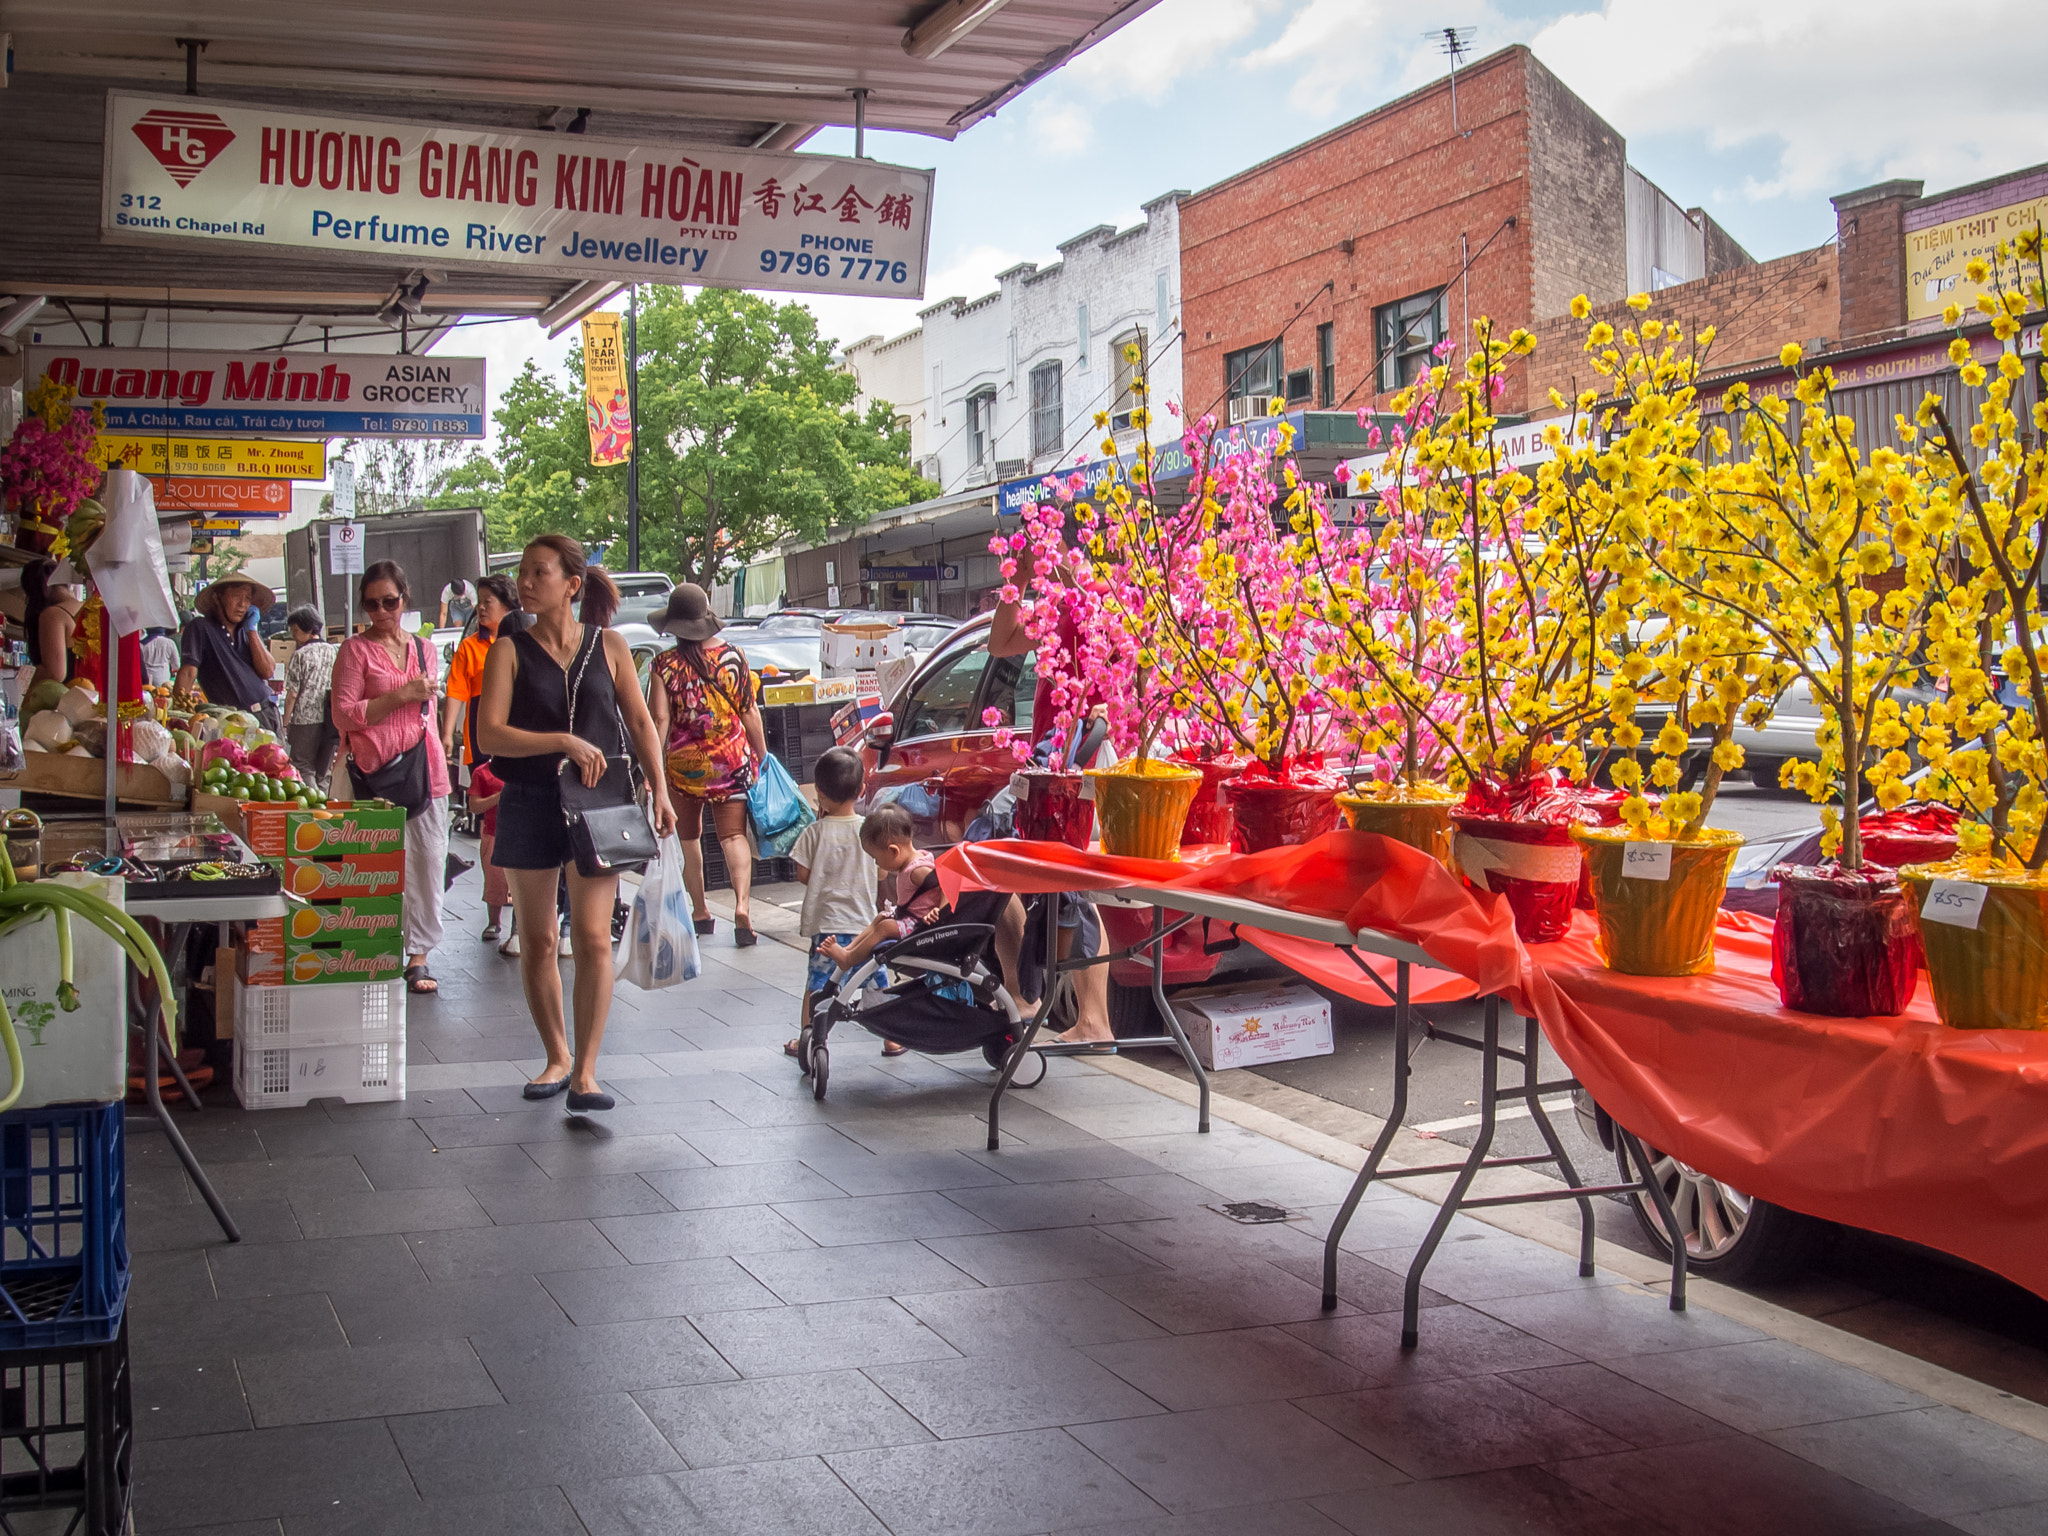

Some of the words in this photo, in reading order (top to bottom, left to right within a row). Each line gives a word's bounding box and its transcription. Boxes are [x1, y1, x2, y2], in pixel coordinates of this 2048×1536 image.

[419, 140, 539, 207] GIANG
[554, 153, 627, 215] KIM
[119, 194, 162, 210] 312
[753, 177, 913, 232] 香江金鋪
[116, 213, 171, 229] South
[176, 216, 237, 235] Chapel
[241, 221, 265, 236] Rd
[680, 227, 707, 239] PTY
[711, 229, 738, 241] LTD
[312, 209, 450, 247] Perfume
[465, 223, 547, 254] River
[561, 231, 709, 272] Jewellery
[800, 234, 874, 254] PHONE
[760, 249, 831, 277] 9796
[839, 256, 908, 284] 7776
[590, 348, 615, 357] YEAR
[599, 358, 617, 366] THE
[385, 366, 451, 383] ASIAN
[1865, 358, 1916, 379] SOUTH
[48, 357, 216, 406] Quang
[223, 357, 352, 401] Minh
[362, 385, 470, 404] GROCERY
[462, 403, 481, 414] 314
[185, 414, 212, 426] Rau
[361, 417, 388, 430] Tel:
[392, 419, 428, 432] 9790
[432, 419, 468, 432] 1853
[247, 447, 264, 458] Mr.
[269, 447, 304, 460] Zhong
[237, 462, 271, 474] B.B.Q
[275, 464, 315, 474] HOUSE
[165, 479, 261, 500] BOUTIQUE
[326, 819, 400, 850] Mangoes
[1626, 849, 1662, 863] $55
[324, 863, 399, 893] Mangoes
[1933, 888, 1976, 908] $55
[324, 907, 398, 937] Mangoes
